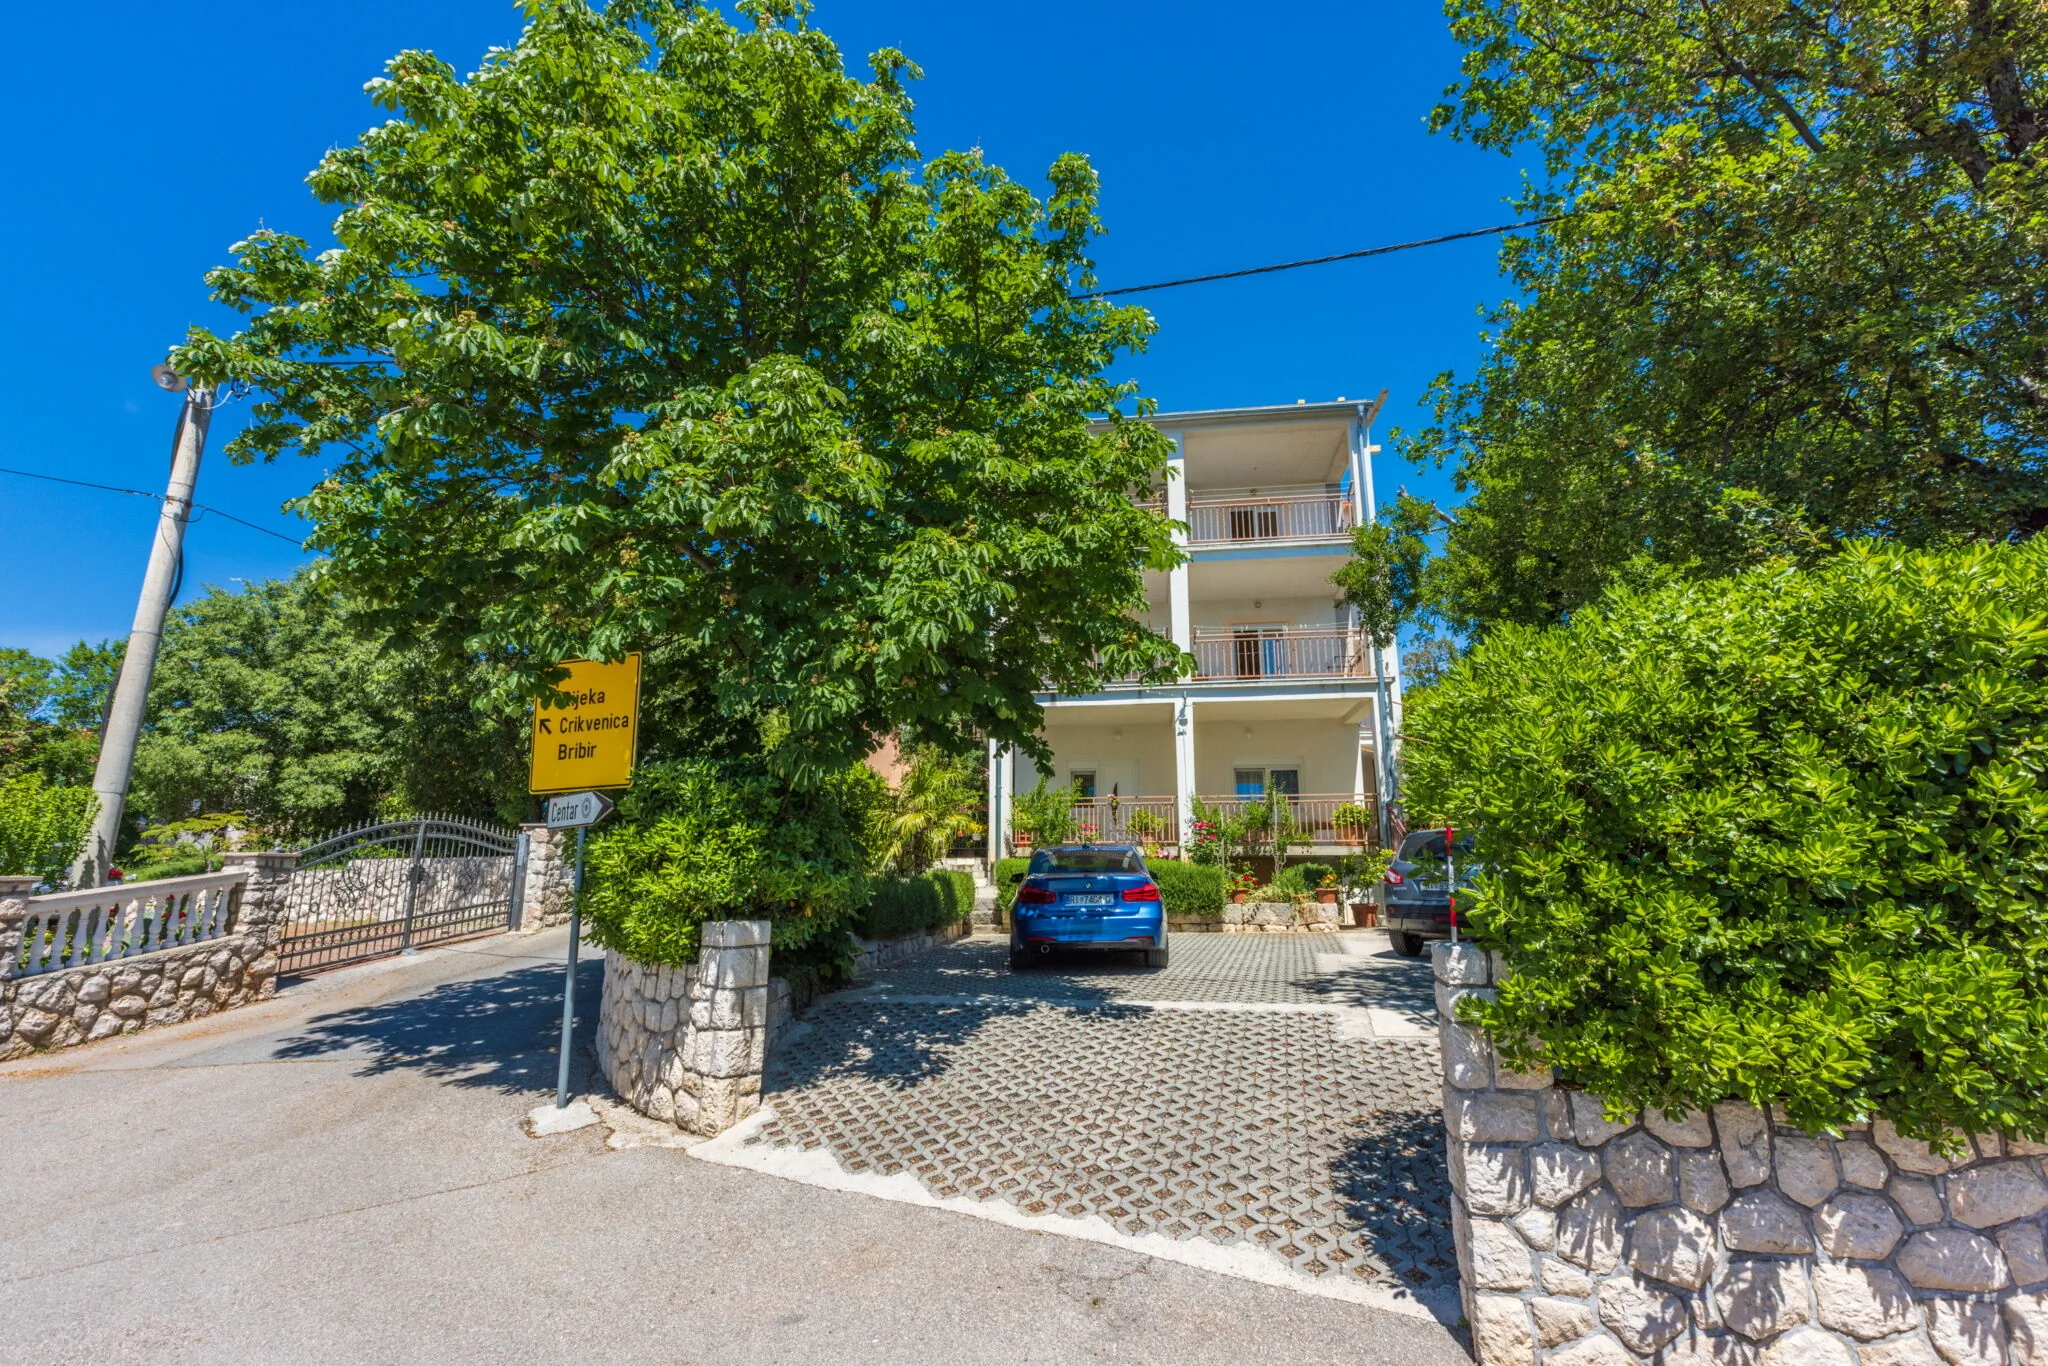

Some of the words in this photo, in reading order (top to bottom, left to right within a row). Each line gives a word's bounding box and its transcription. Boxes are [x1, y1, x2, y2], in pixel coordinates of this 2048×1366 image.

[560, 713, 629, 734] Crikvenica
[558, 741, 597, 760] Bribir
[551, 801, 579, 822] Centar
